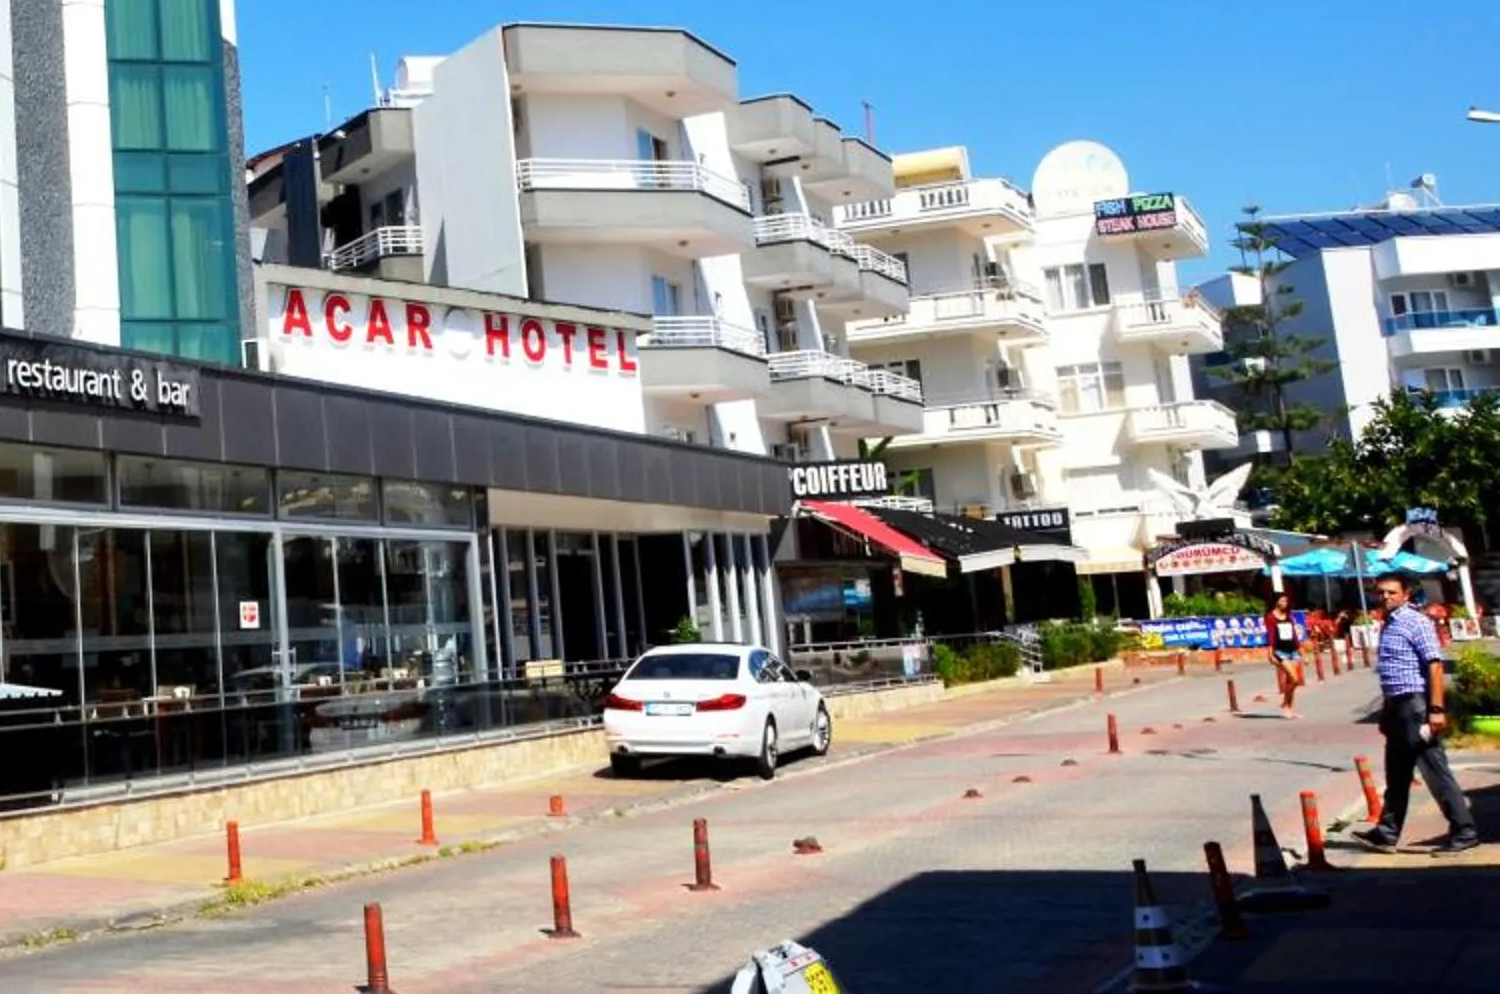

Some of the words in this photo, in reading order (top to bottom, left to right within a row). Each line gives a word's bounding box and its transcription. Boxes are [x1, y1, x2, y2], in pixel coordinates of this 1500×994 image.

[1132, 195, 1172, 212] PIZZA
[1098, 216, 1135, 233] STEAK
[1137, 210, 1175, 229] HOUSE
[283, 287, 433, 350] ACAR
[484, 310, 637, 371] HOTEL
[7, 358, 121, 399] restaurant
[131, 369, 148, 401] &
[157, 370, 190, 406] bar
[793, 462, 888, 496] COIFFEUR
